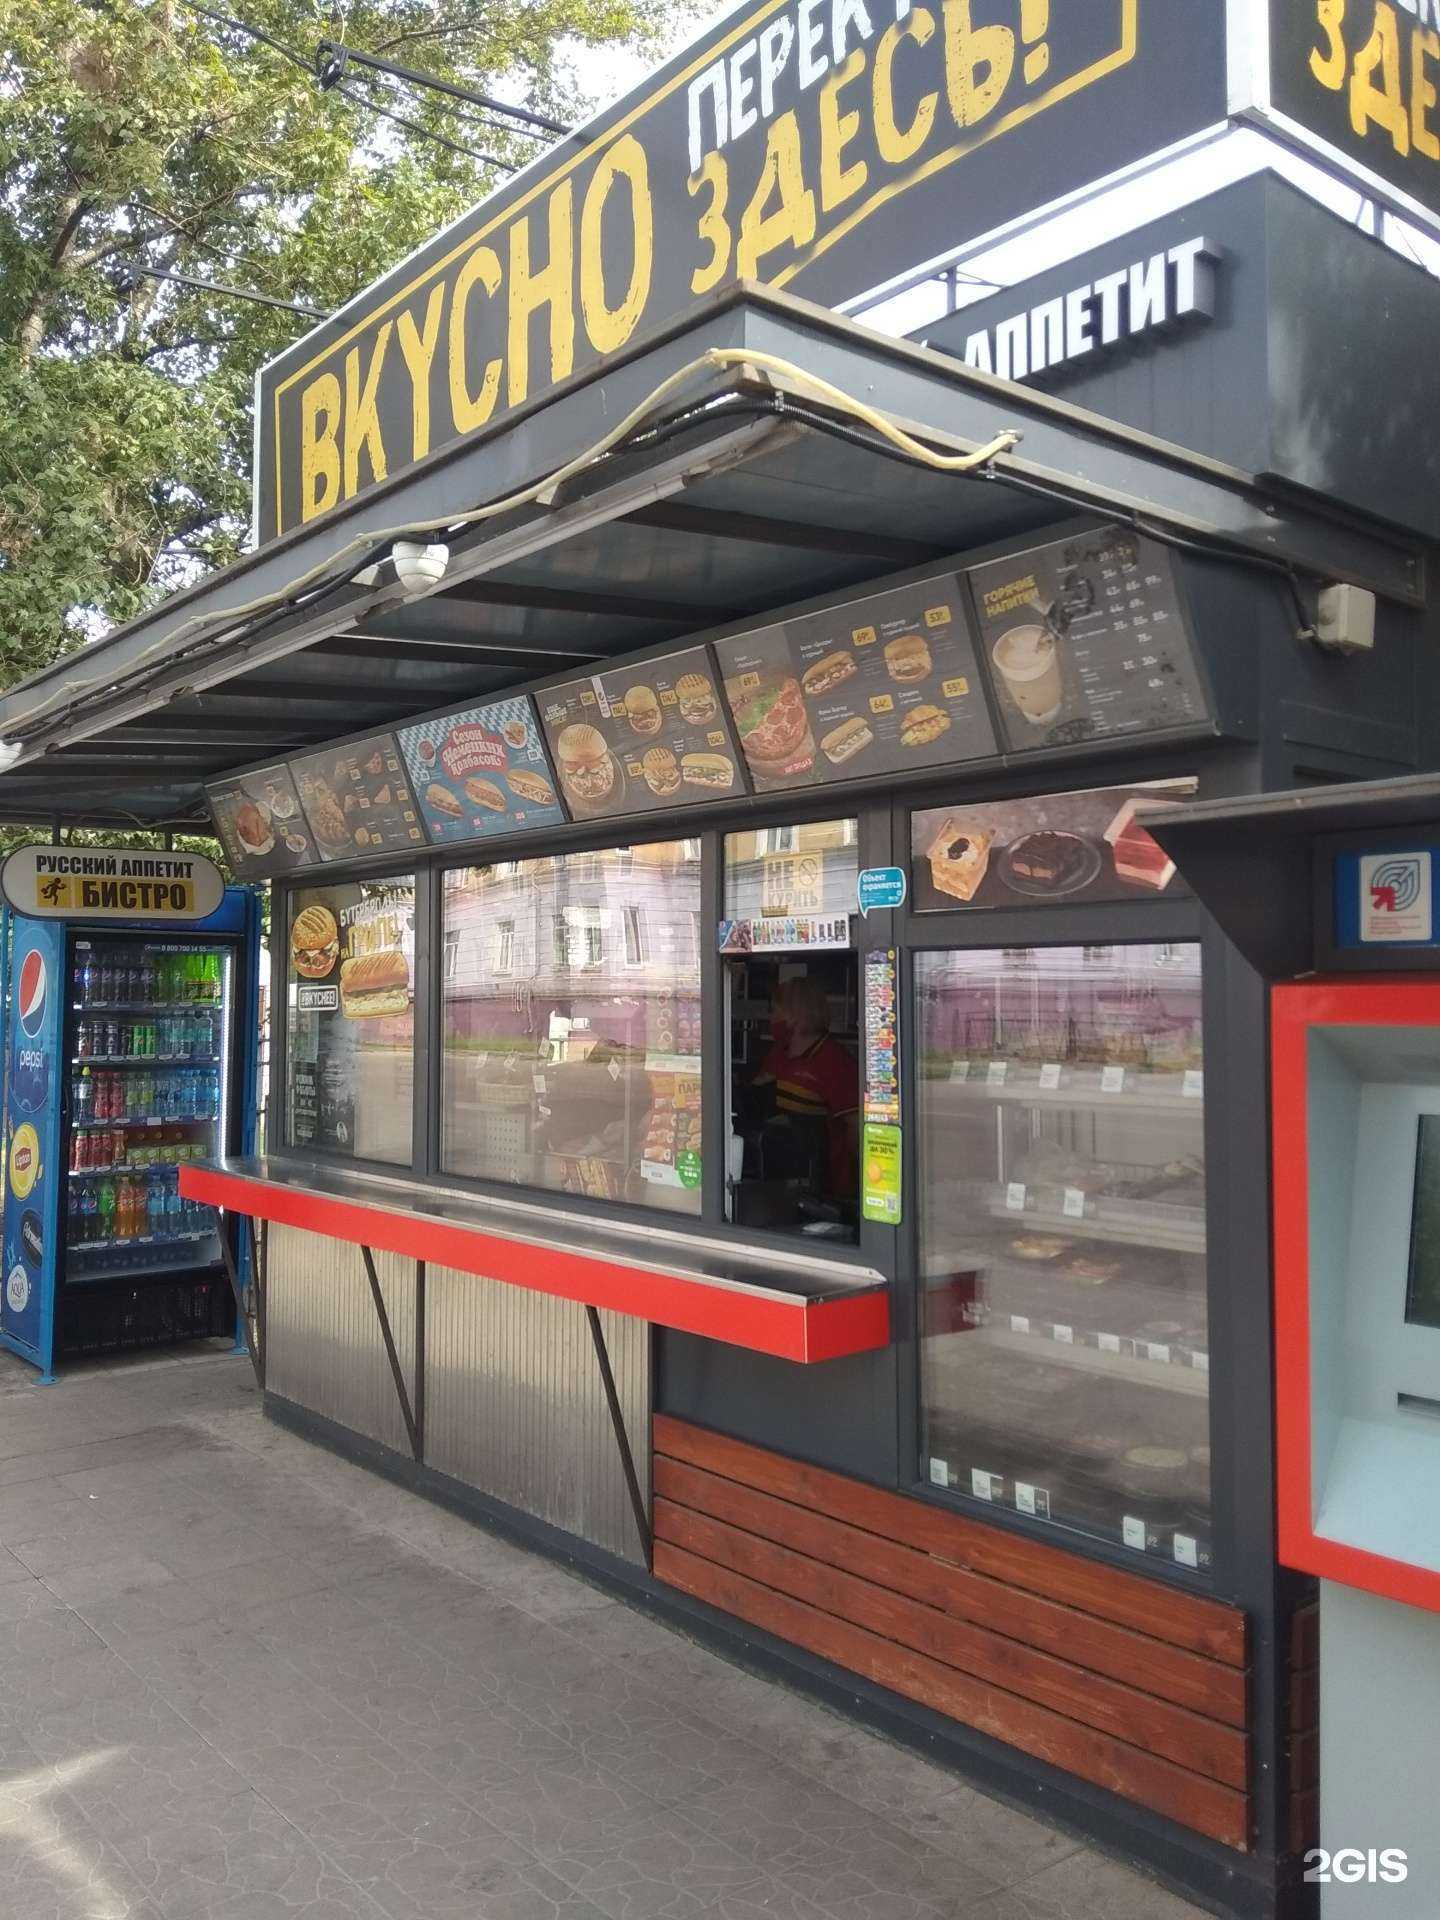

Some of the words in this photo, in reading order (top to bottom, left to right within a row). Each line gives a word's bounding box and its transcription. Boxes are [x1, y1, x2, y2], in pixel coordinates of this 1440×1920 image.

[687, 0, 911, 174] ПЕРЕК
[963, 236, 1205, 382] АППЕТИТ
[303, 132, 653, 524] ВКУСНО
[452, 729, 483, 746] Сезон
[35, 854, 117, 878] РУССКИЙ
[120, 860, 194, 879] АППЕТИТ
[82, 880, 187, 910] БИСТРО
[20, 1048, 43, 1072] pepsi
